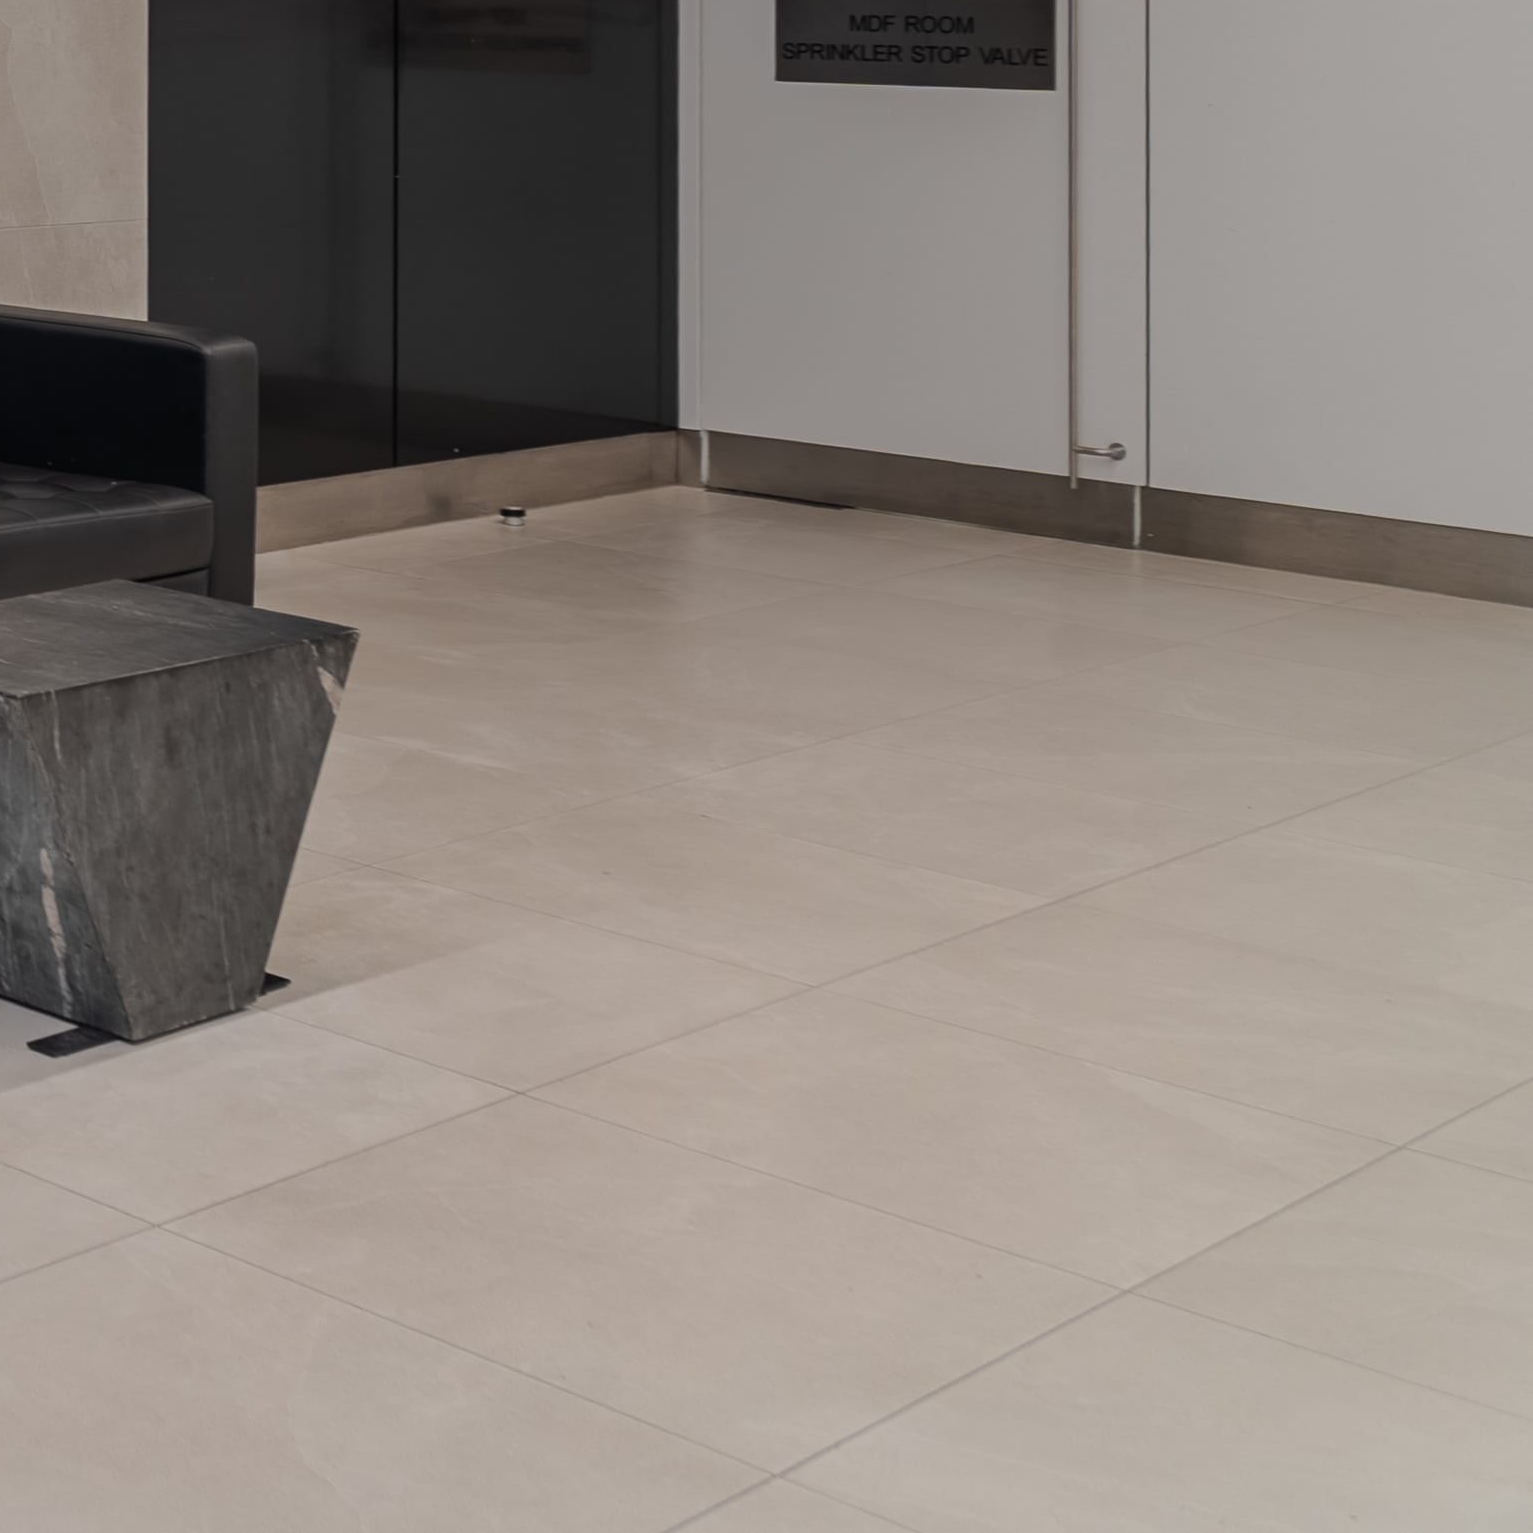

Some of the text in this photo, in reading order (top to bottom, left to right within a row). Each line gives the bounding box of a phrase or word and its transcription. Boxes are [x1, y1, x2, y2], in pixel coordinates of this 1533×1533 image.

[849, 14, 976, 34] MDF ROOM
[781, 41, 1049, 68] SPRINKLER STOP VALVE
